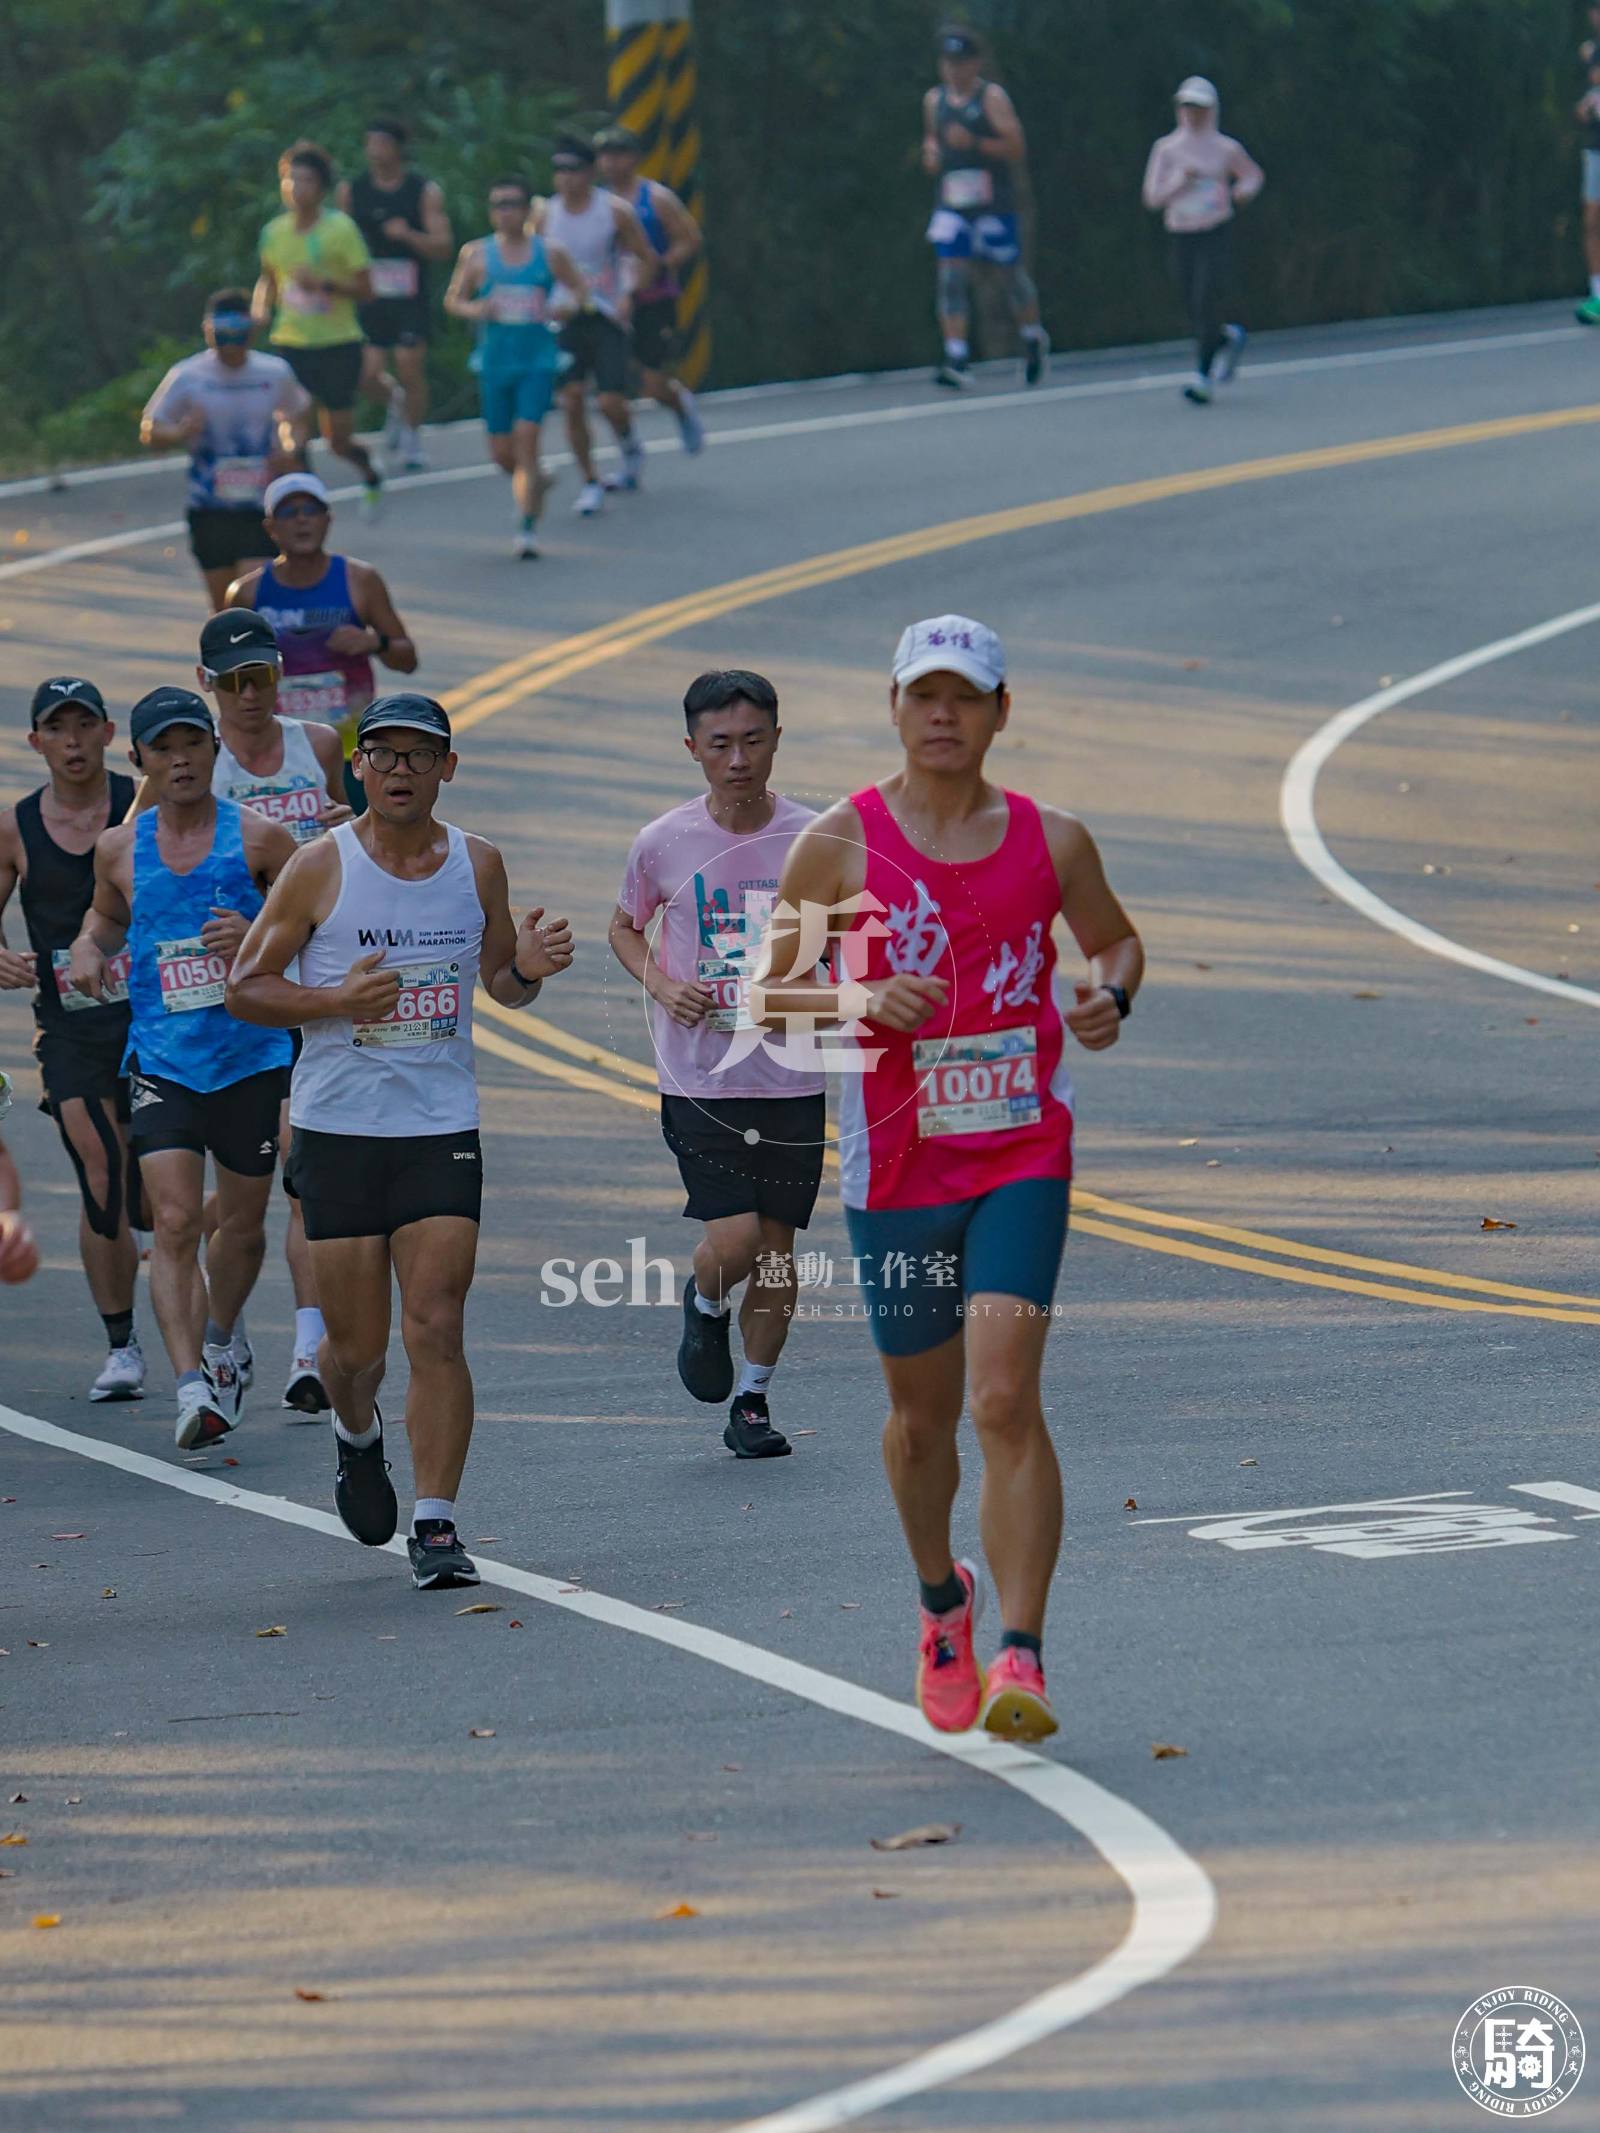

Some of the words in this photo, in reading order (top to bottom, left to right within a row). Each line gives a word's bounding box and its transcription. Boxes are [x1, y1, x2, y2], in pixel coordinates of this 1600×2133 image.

[418, 936, 466, 946] MARATHON
[380, 988, 456, 1021] 666
[920, 1058, 1036, 1104] 10074
